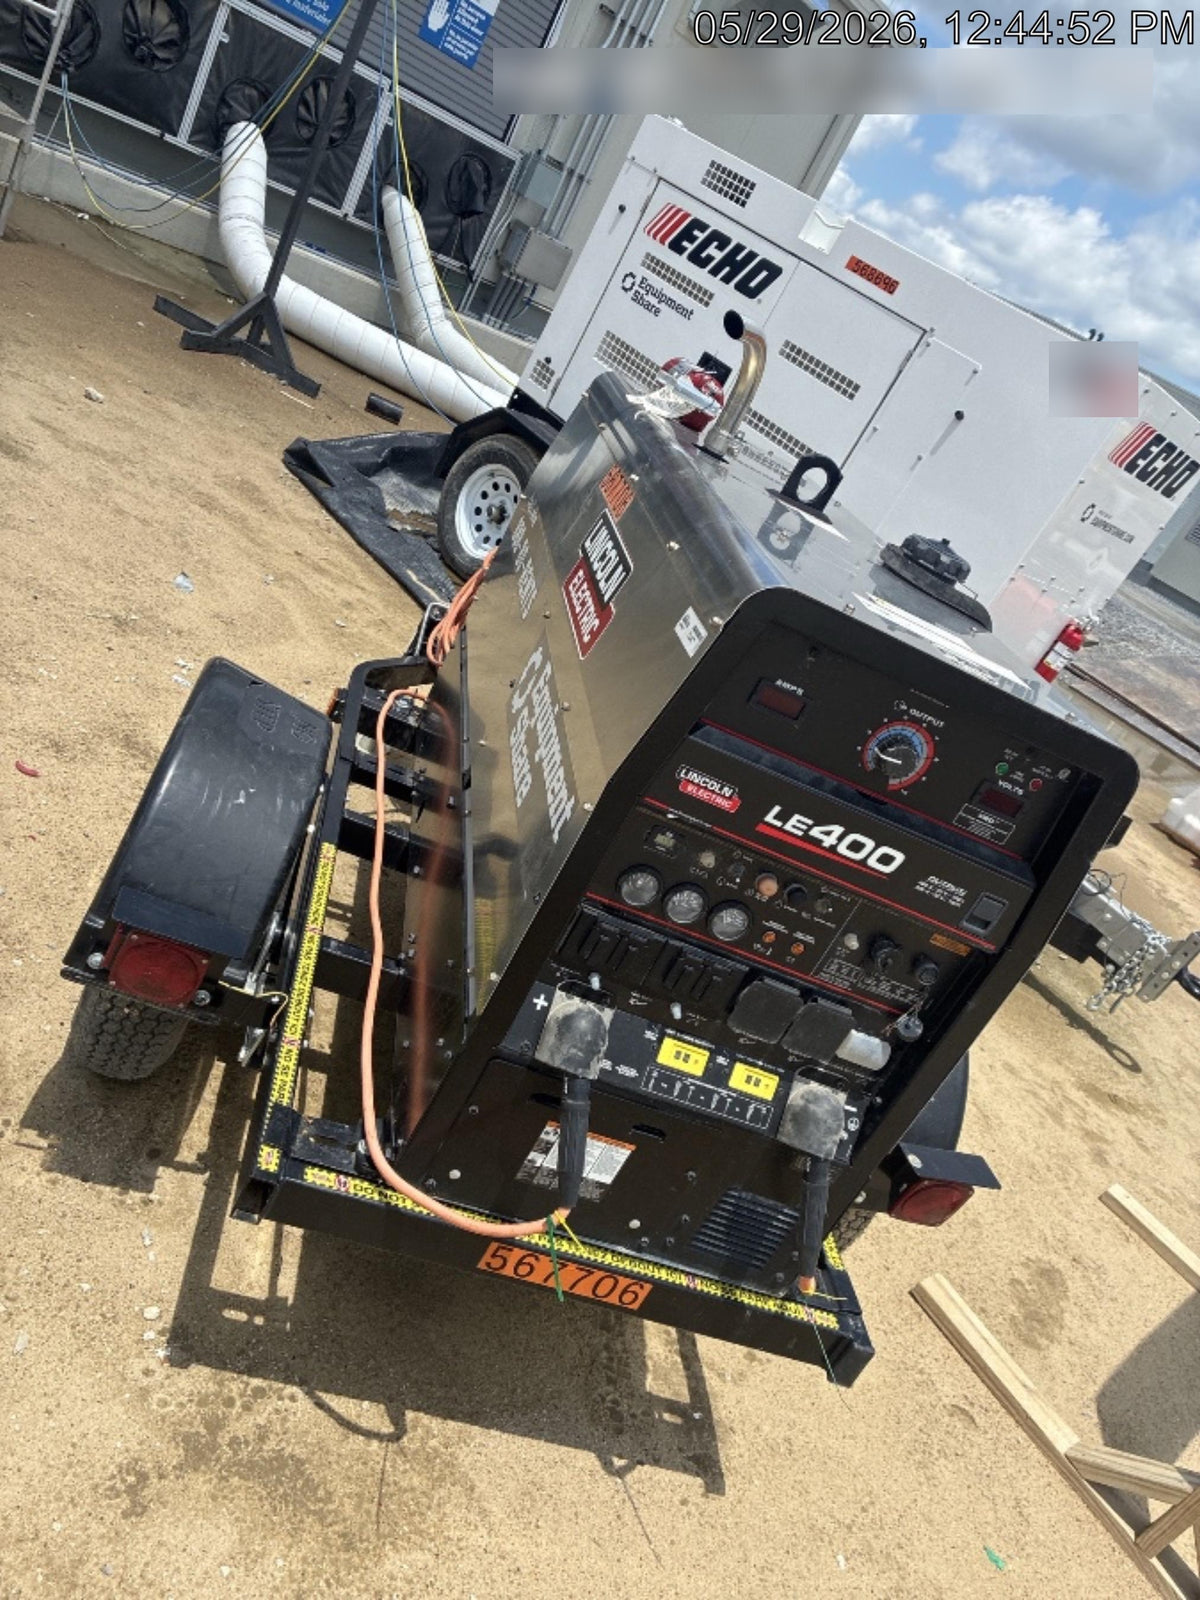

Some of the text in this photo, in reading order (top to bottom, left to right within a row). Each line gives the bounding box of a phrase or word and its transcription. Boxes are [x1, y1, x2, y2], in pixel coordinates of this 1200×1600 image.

[668, 216, 783, 300] ECHO
[630, 290, 662, 317] Share
[638, 276, 694, 321] Equipment
[1123, 432, 1200, 499] ECHO
[585, 517, 627, 604] LINCOLN
[567, 568, 600, 644] ELECTRIC
[774, 678, 805, 696] AMPS
[909, 708, 946, 728] OUTPUT
[510, 705, 532, 808] Share
[521, 660, 575, 844] Equipment
[679, 768, 735, 798] LINCOLN
[686, 783, 735, 809] ELECTRIC
[998, 778, 1025, 797] VOLTS
[763, 804, 906, 875] LE400
[353, 1183, 374, 1195] DO
[485, 1245, 644, 1306] 567706
